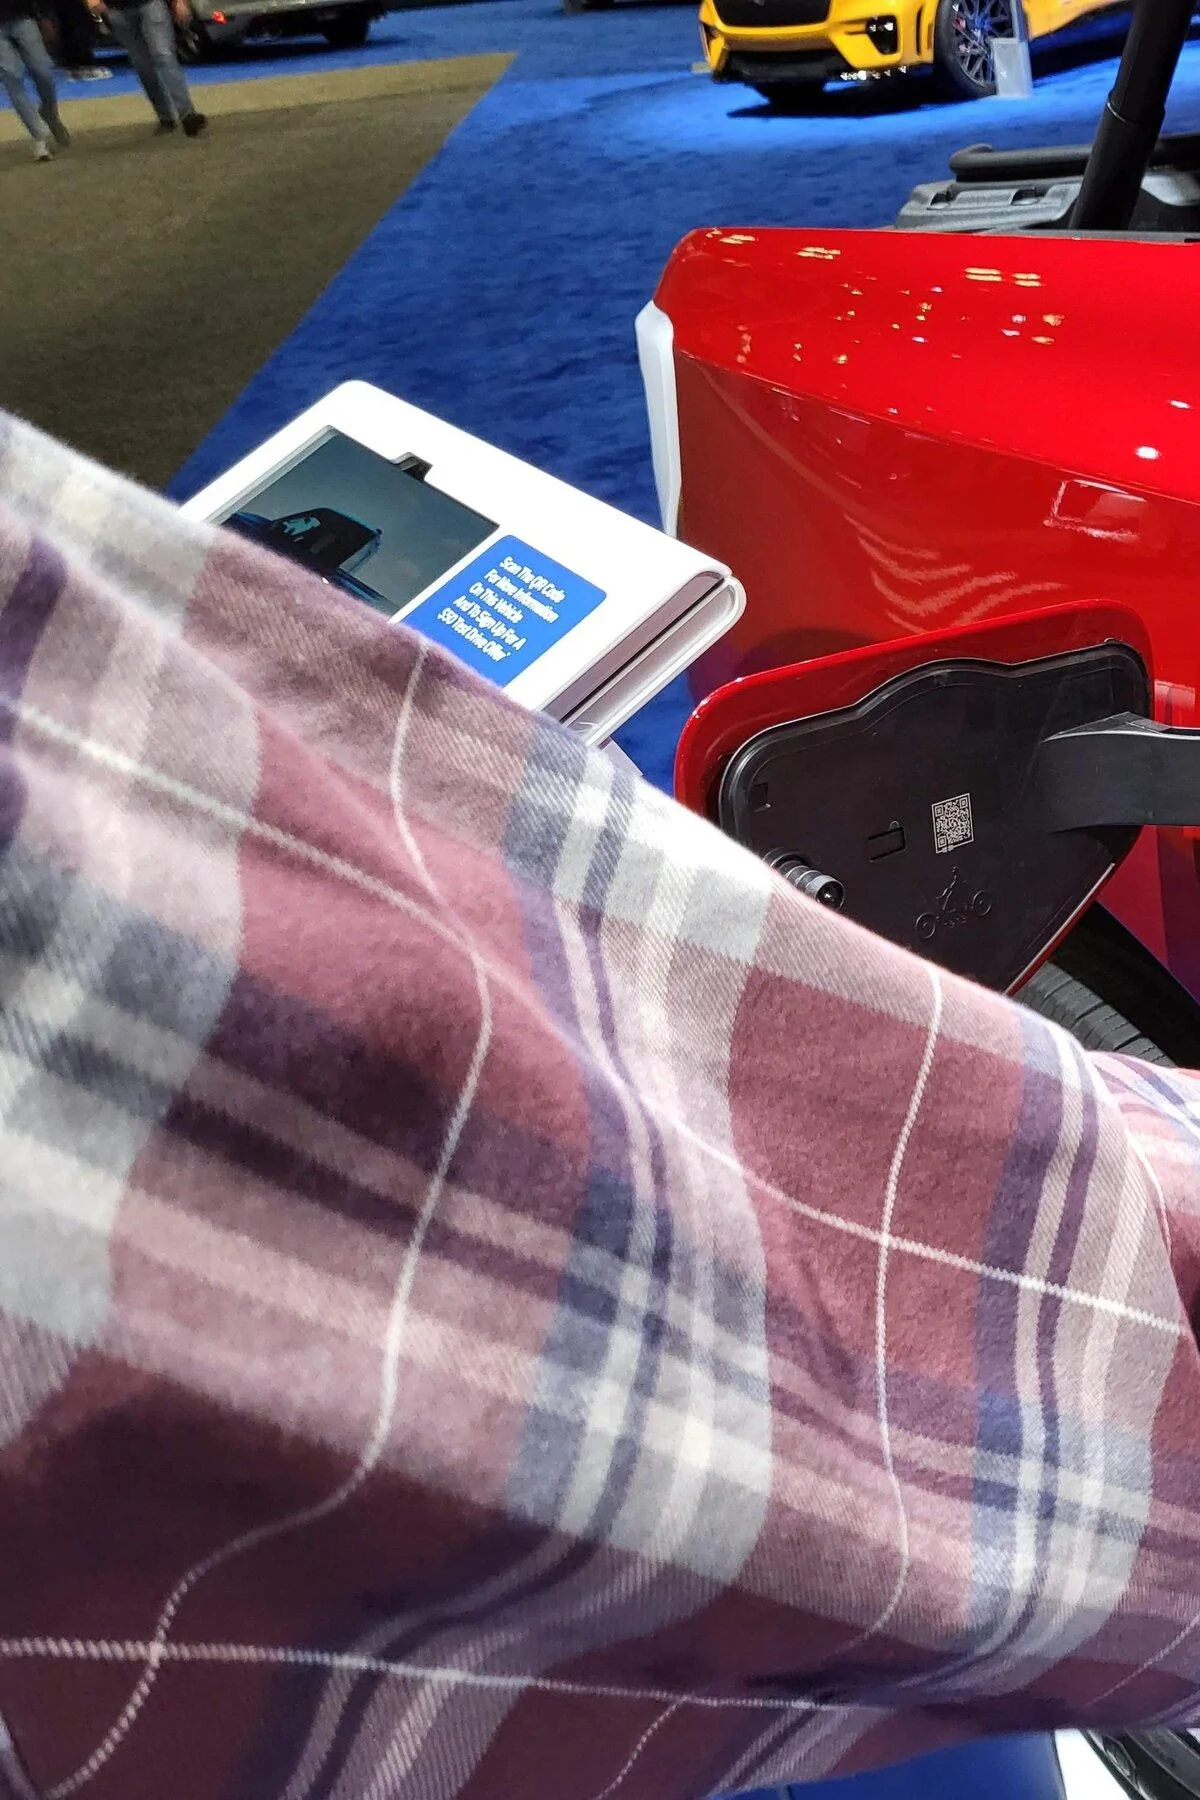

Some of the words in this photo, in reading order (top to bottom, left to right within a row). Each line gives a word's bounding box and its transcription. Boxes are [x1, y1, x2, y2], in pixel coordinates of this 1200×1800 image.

[469, 581, 485, 596] On
[480, 588, 499, 606] This
[494, 597, 524, 624] Vehicle
[484, 568, 501, 584] For
[495, 576, 519, 596] More
[512, 587, 560, 624] Information
[500, 556, 522, 575] Scan
[517, 566, 535, 584] The
[529, 575, 549, 591] QR
[541, 583, 566, 603] Code
[451, 616, 473, 636] Test
[464, 626, 489, 649] Drive
[452, 595, 475, 612] And
[467, 601, 482, 618] To
[475, 610, 497, 629] Sign
[490, 620, 508, 637] Up
[501, 628, 520, 645] For
[512, 637, 527, 651] A
